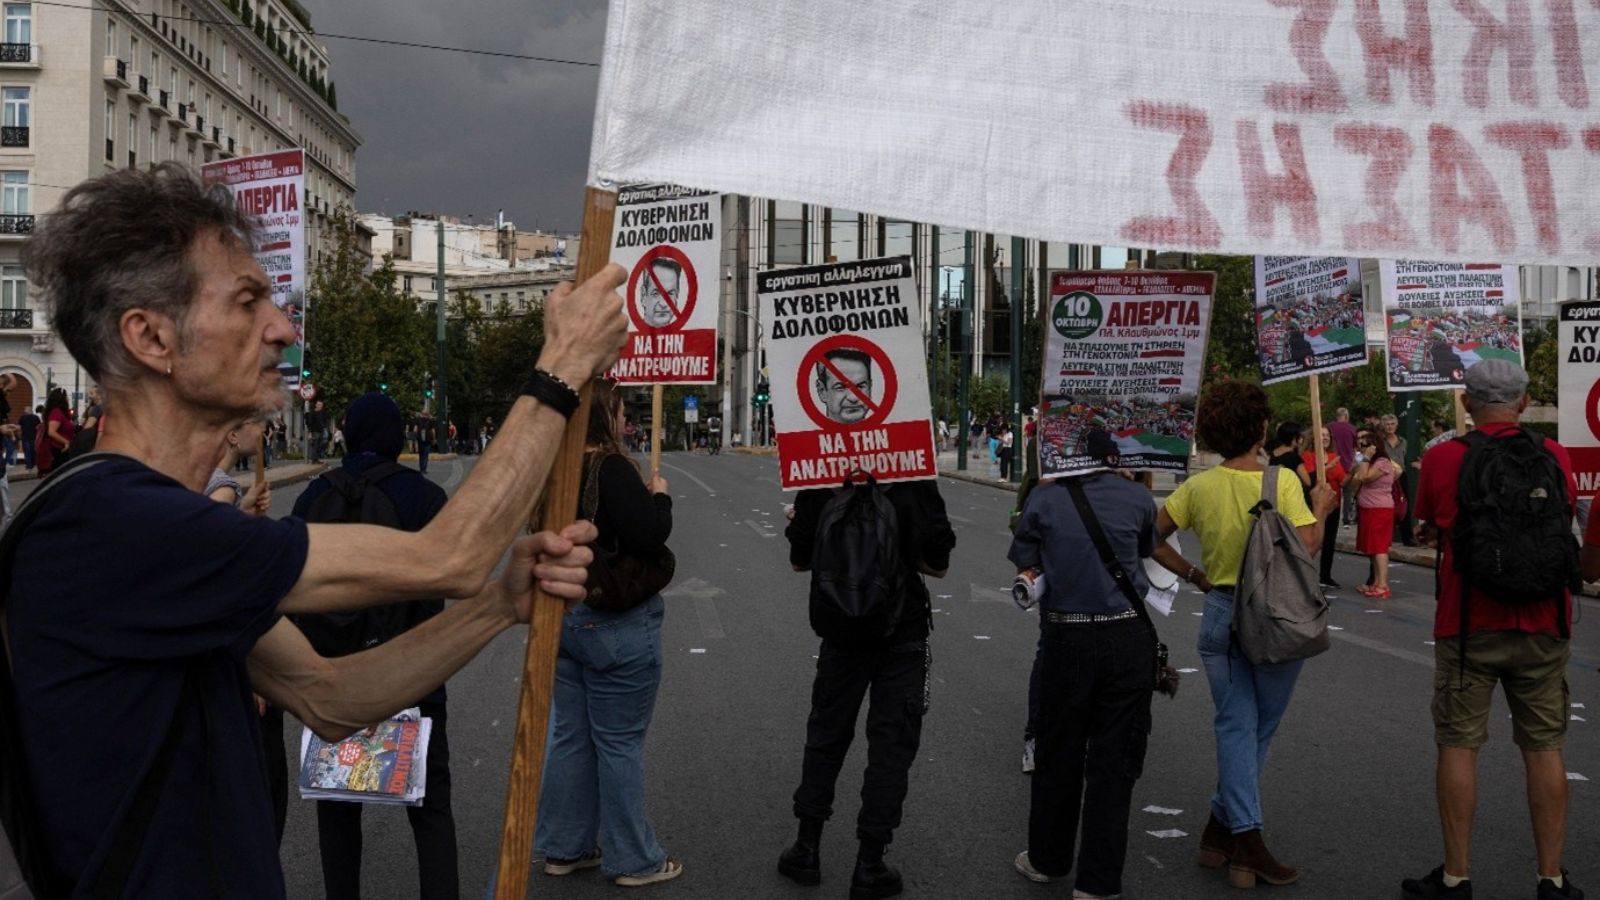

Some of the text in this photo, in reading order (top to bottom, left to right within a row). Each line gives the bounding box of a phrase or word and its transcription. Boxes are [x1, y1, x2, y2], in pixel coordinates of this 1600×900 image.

[621, 202, 709, 227] ΚΥΒΕΡΝΗΣΗ
[616, 223, 713, 248] ΔΟΛΟΦΟΝΩΝ
[1396, 265, 1411, 274] ΣΤΗ
[1413, 263, 1463, 273] ΓΕΝΟΚΤΟΝΙΑ
[1397, 273, 1502, 285] ΛΕΥΤΕΡΙΑ ΣΤΗΝ ΠΑΛΑΙΣΤΙΝΗ
[774, 285, 900, 317] ΚΥΒΕΡΝΗΣΗ
[1398, 290, 1484, 301] ΔΟΥΛΕΙΕΣ ΑΥΞΗΣΕΙΣ
[1064, 296, 1091, 317] 10
[1411, 301, 1440, 309] ΒΟΜΒΕΣ
[1443, 300, 1455, 308] ΚΑΙ
[1106, 301, 1200, 327] ΑΠΕΡΓΙΑ
[772, 307, 909, 340] ΔΟΛΟΦΟΝΩΝ
[1056, 318, 1098, 328] ΟΚΤΩΒΡΗ
[1117, 326, 1179, 339] Κλαυθμώνος
[1181, 327, 1200, 340] 1μμ
[634, 334, 684, 355] ΝΑ ΤΗΝ
[1063, 341, 1185, 352] ΝΑ ΣΠΑΣΟΥΜΕ ΤΗ ΣΤΗΡΙΞΗ
[1063, 350, 1138, 360] ΣΤΗ ΓΕΝΟΚΤΟΝΙΑ
[610, 356, 709, 377] ΑΝΑΤΡΕΨΟΥΜΕ
[1061, 361, 1184, 371] ΛΕΥΤΕΡΙΑ ΣΤΗΝ ΠΑΛΑΙΣΤΙΝΗ
[1060, 378, 1158, 388] ΔΟΥΛΕΙΕΣ ΑΥΞΗΣΕΙΣ
[818, 429, 889, 454] ΝΑ ΤΗΝ
[789, 450, 927, 482] ΑΝΑΤΡΕΨΟΥΜΕ
